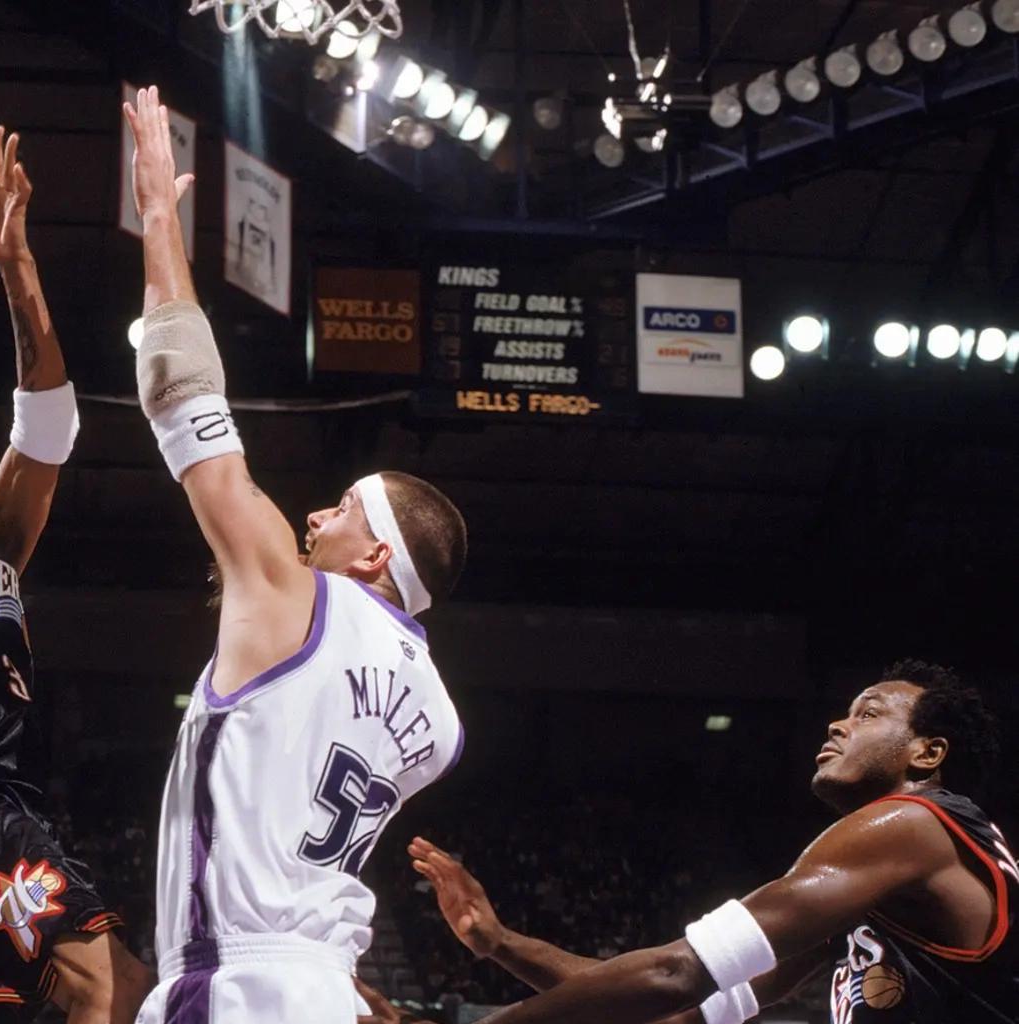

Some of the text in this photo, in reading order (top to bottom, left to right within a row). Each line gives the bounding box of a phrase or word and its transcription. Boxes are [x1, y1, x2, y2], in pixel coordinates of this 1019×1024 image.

[438, 266, 500, 288] KINGS
[318, 298, 414, 320] WELLS
[474, 292, 521, 311] FIELD
[649, 312, 701, 328] ARCO
[322, 321, 413, 342] FARGO
[494, 340, 566, 360] ASSISTS
[482, 362, 579, 384] TURNOVERS
[456, 390, 520, 412] WELLS
[345, 665, 435, 776] MILLER
